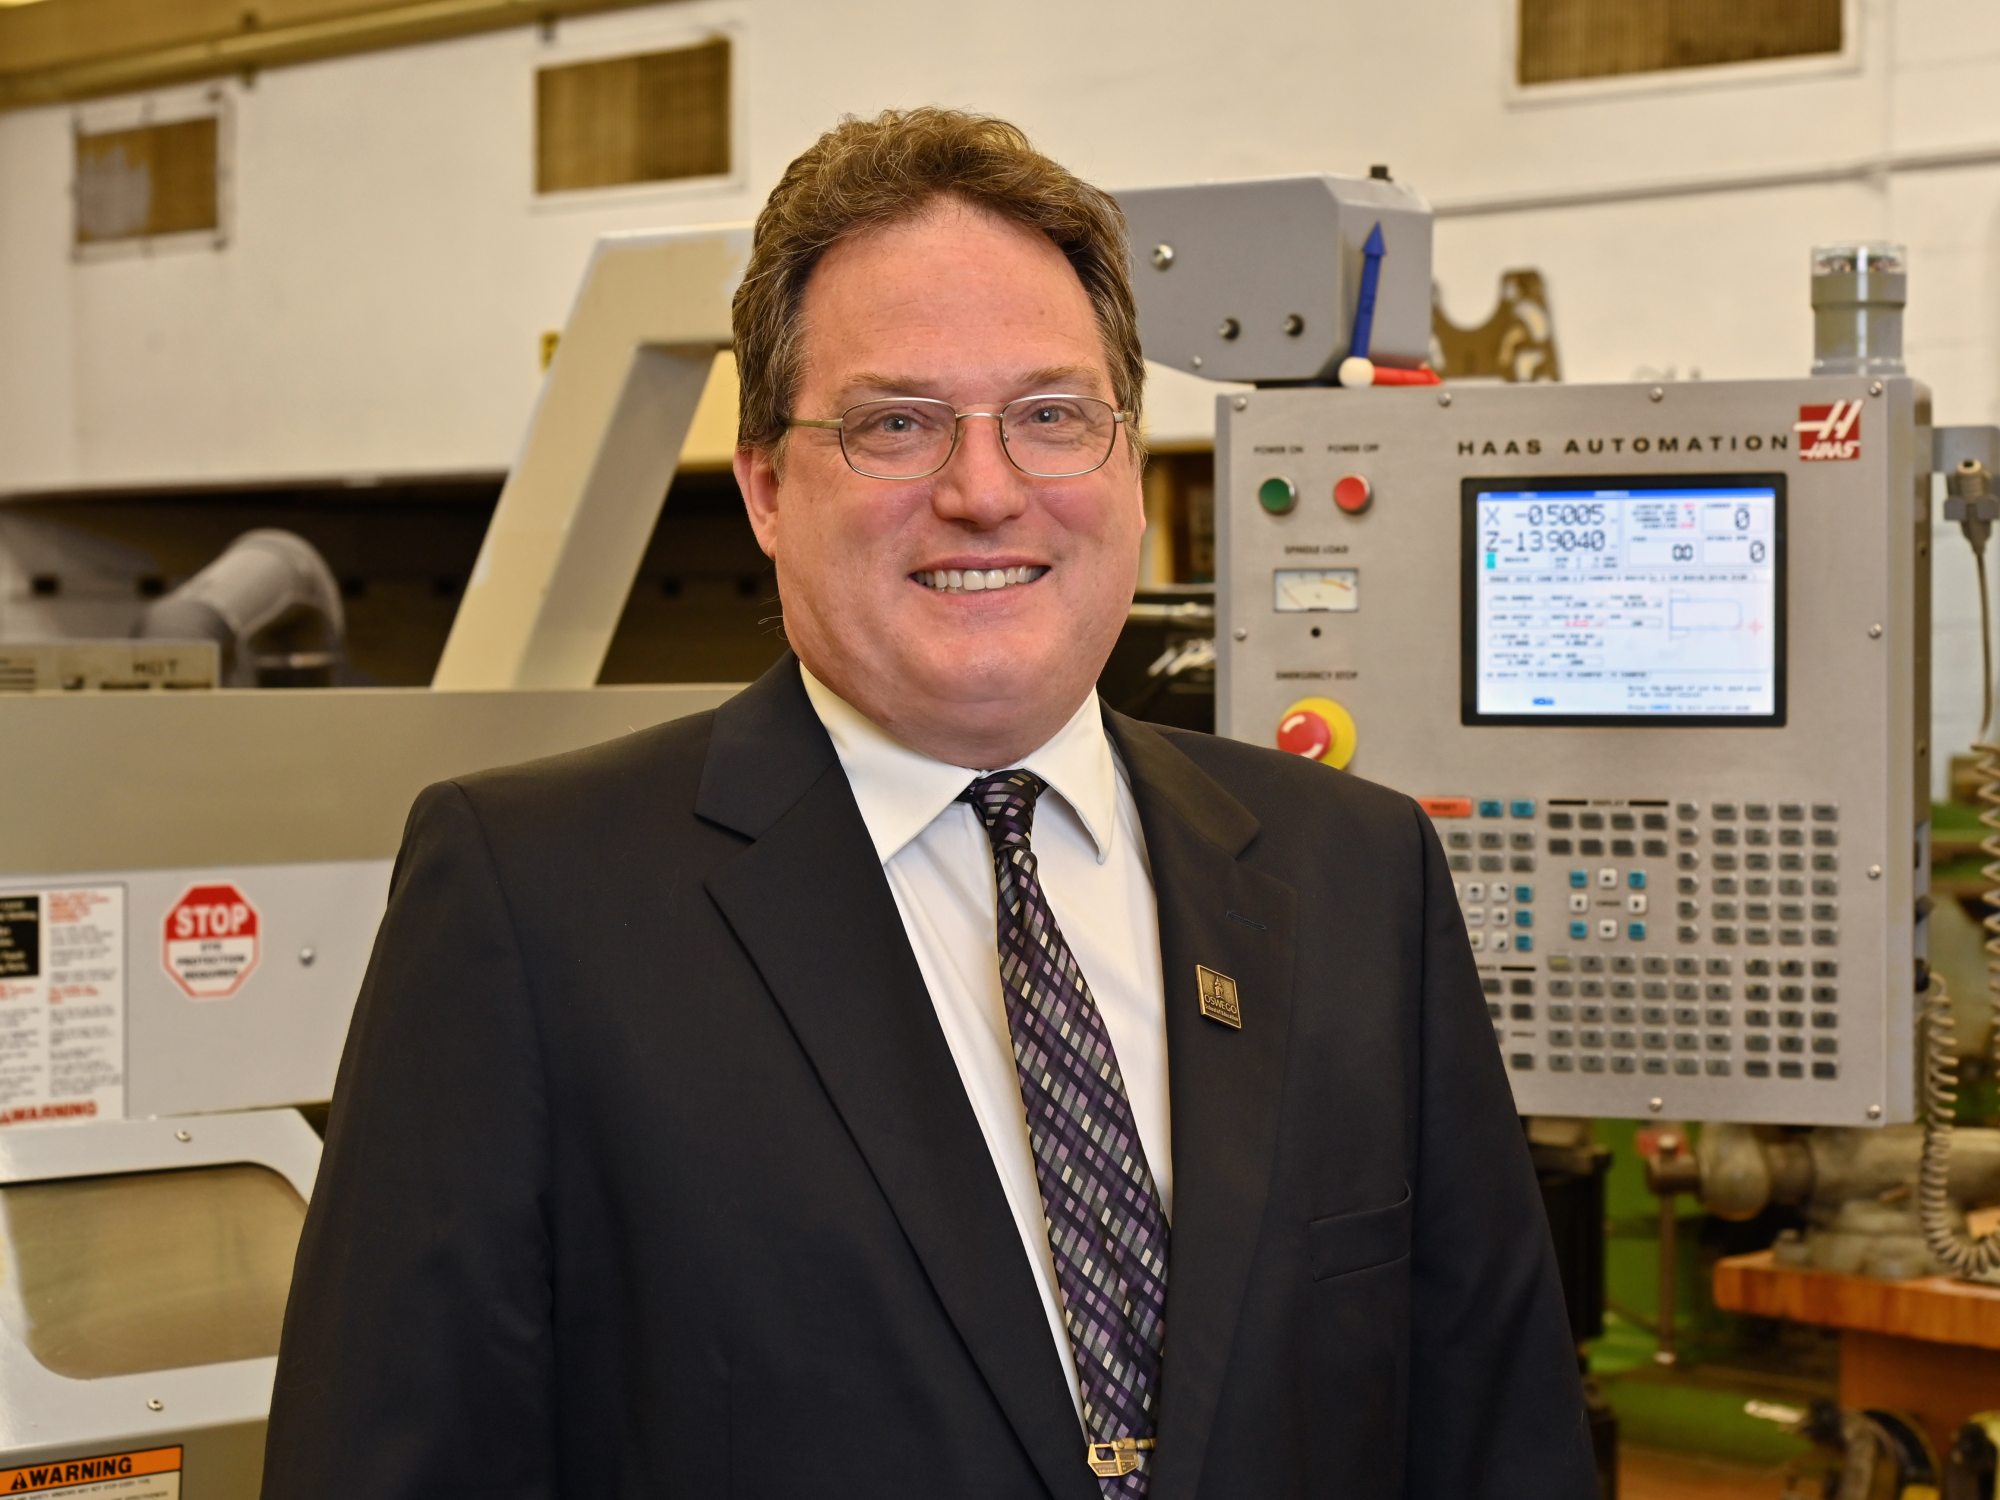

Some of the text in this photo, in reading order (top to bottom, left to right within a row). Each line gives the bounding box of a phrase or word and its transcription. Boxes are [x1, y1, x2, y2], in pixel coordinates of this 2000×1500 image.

[1457, 434, 1788, 456] HAAS AUTOMATION
[1485, 505, 1500, 525] X
[174, 903, 249, 938] STOP
[1204, 994, 1238, 1014] OSWEGO
[29, 1456, 132, 1487] WARNING
